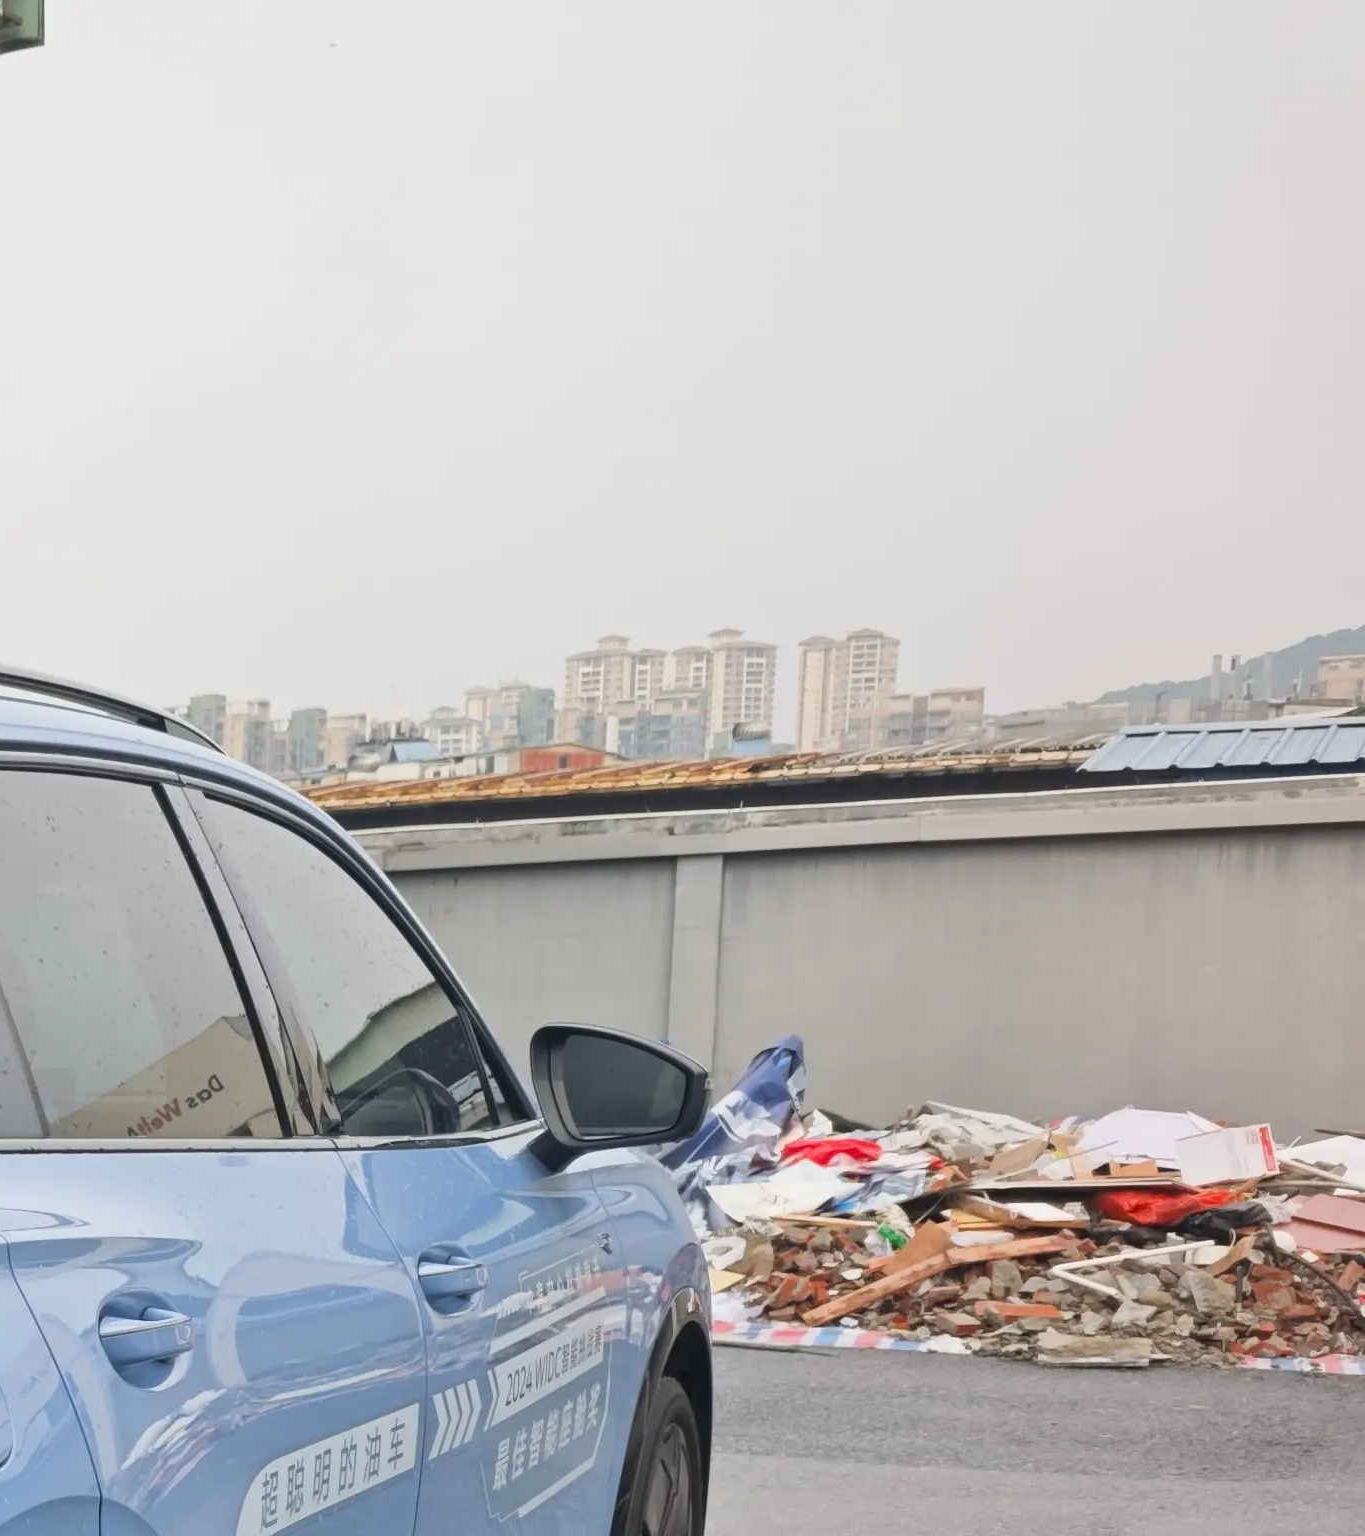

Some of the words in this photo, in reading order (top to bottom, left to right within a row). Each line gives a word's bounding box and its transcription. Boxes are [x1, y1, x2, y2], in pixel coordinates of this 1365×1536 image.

[492, 1381, 602, 1492] 最佳智能座舱奖
[505, 1365, 532, 1407] 2024
[259, 1416, 407, 1533] 超聪明的油车
